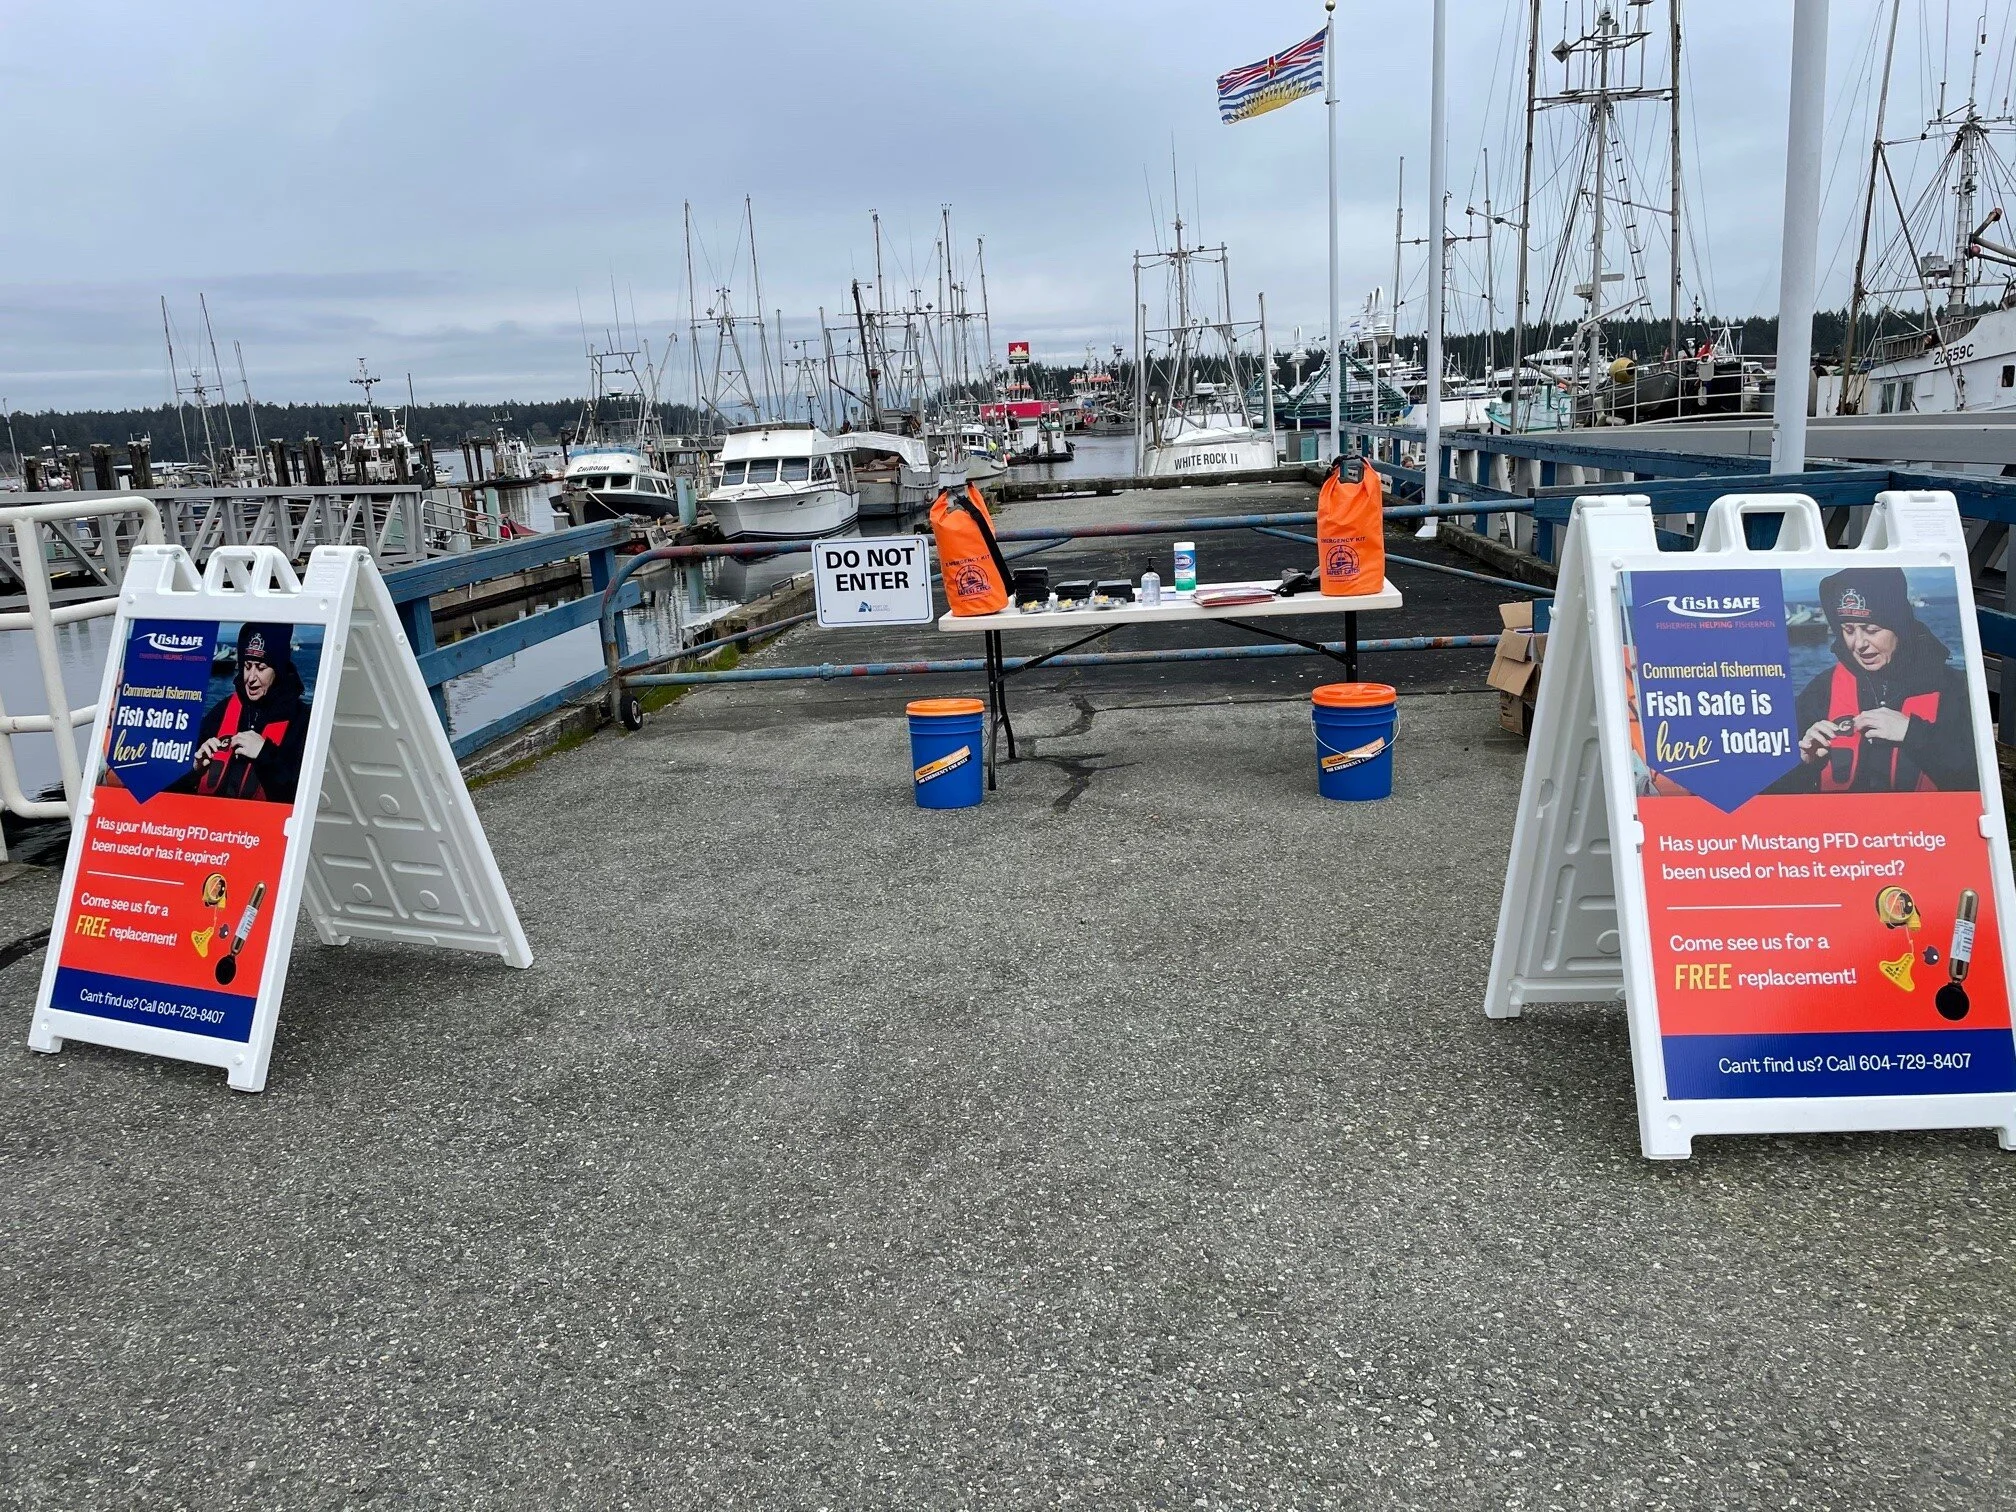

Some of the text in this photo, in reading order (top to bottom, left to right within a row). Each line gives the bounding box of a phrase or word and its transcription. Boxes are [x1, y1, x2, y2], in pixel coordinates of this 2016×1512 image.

[1174, 452, 1238, 470] WHITE ROCK II
[826, 548, 915, 569] DO NOT
[946, 558, 979, 567] EMERGENCY
[836, 571, 909, 592] ENTER
[1682, 596, 1760, 609] fish SAFE
[1656, 622, 1696, 630] FISHERMEN
[1734, 620, 1776, 628] FISHERMEN
[158, 633, 203, 646] fish SAFE
[1642, 660, 1786, 679] Commercial fishermen,
[122, 683, 202, 702] Commercial fishermen,
[1646, 689, 1772, 717] Fish Safe is
[116, 706, 189, 730] Fish Safe is
[114, 729, 192, 762] here today!
[1656, 720, 1791, 763] here today!
[96, 816, 260, 849] Has your Mustang PFD cartridge
[92, 838, 230, 866] been used or has it expired?
[1660, 831, 1946, 856] Has your Mustang PFD cartridge
[1662, 860, 1905, 881] been used or has it expired?
[80, 892, 169, 917] Come see us for a
[74, 914, 177, 947] FREE replacement!
[1670, 932, 1830, 952] Come see us for a
[1675, 964, 1732, 990] FREE
[1738, 968, 1857, 990] replacement!
[80, 988, 225, 1024] Can't find us? Call 604-729-8407
[1718, 1053, 1972, 1074] Can't find us? Call 604-729-8407
